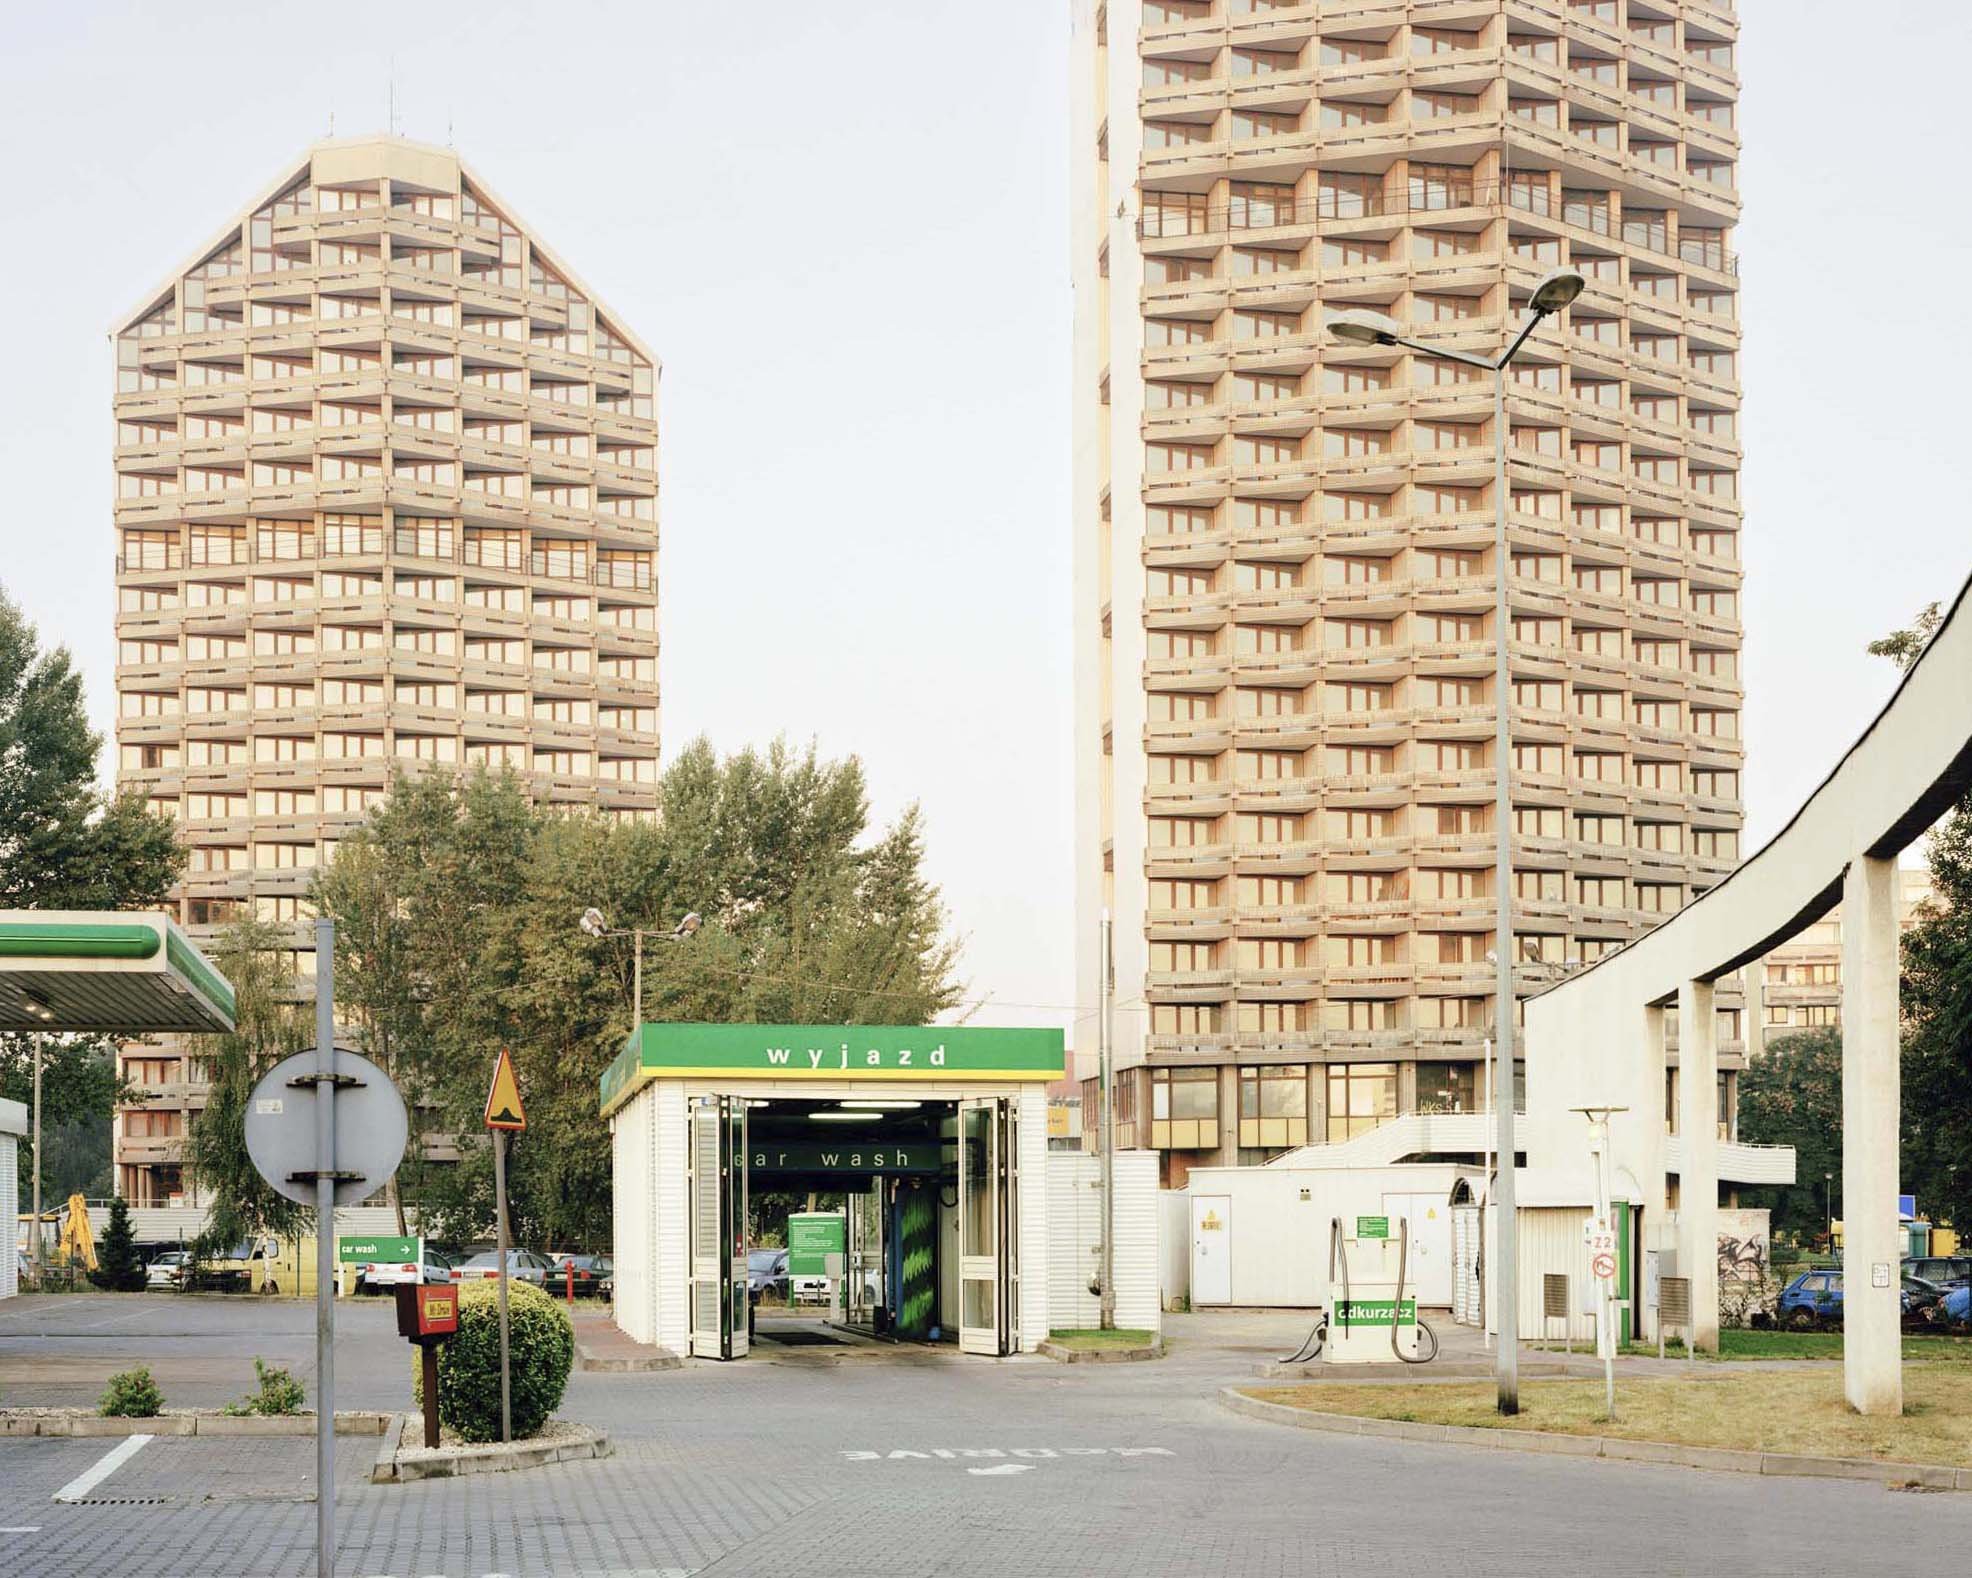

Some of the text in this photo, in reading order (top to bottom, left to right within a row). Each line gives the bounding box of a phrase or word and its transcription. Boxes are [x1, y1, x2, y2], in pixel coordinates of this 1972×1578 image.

[766, 1044, 946, 1069] wyjazd
[821, 1149, 908, 1167] wash
[341, 1243, 377, 1254] car wash
